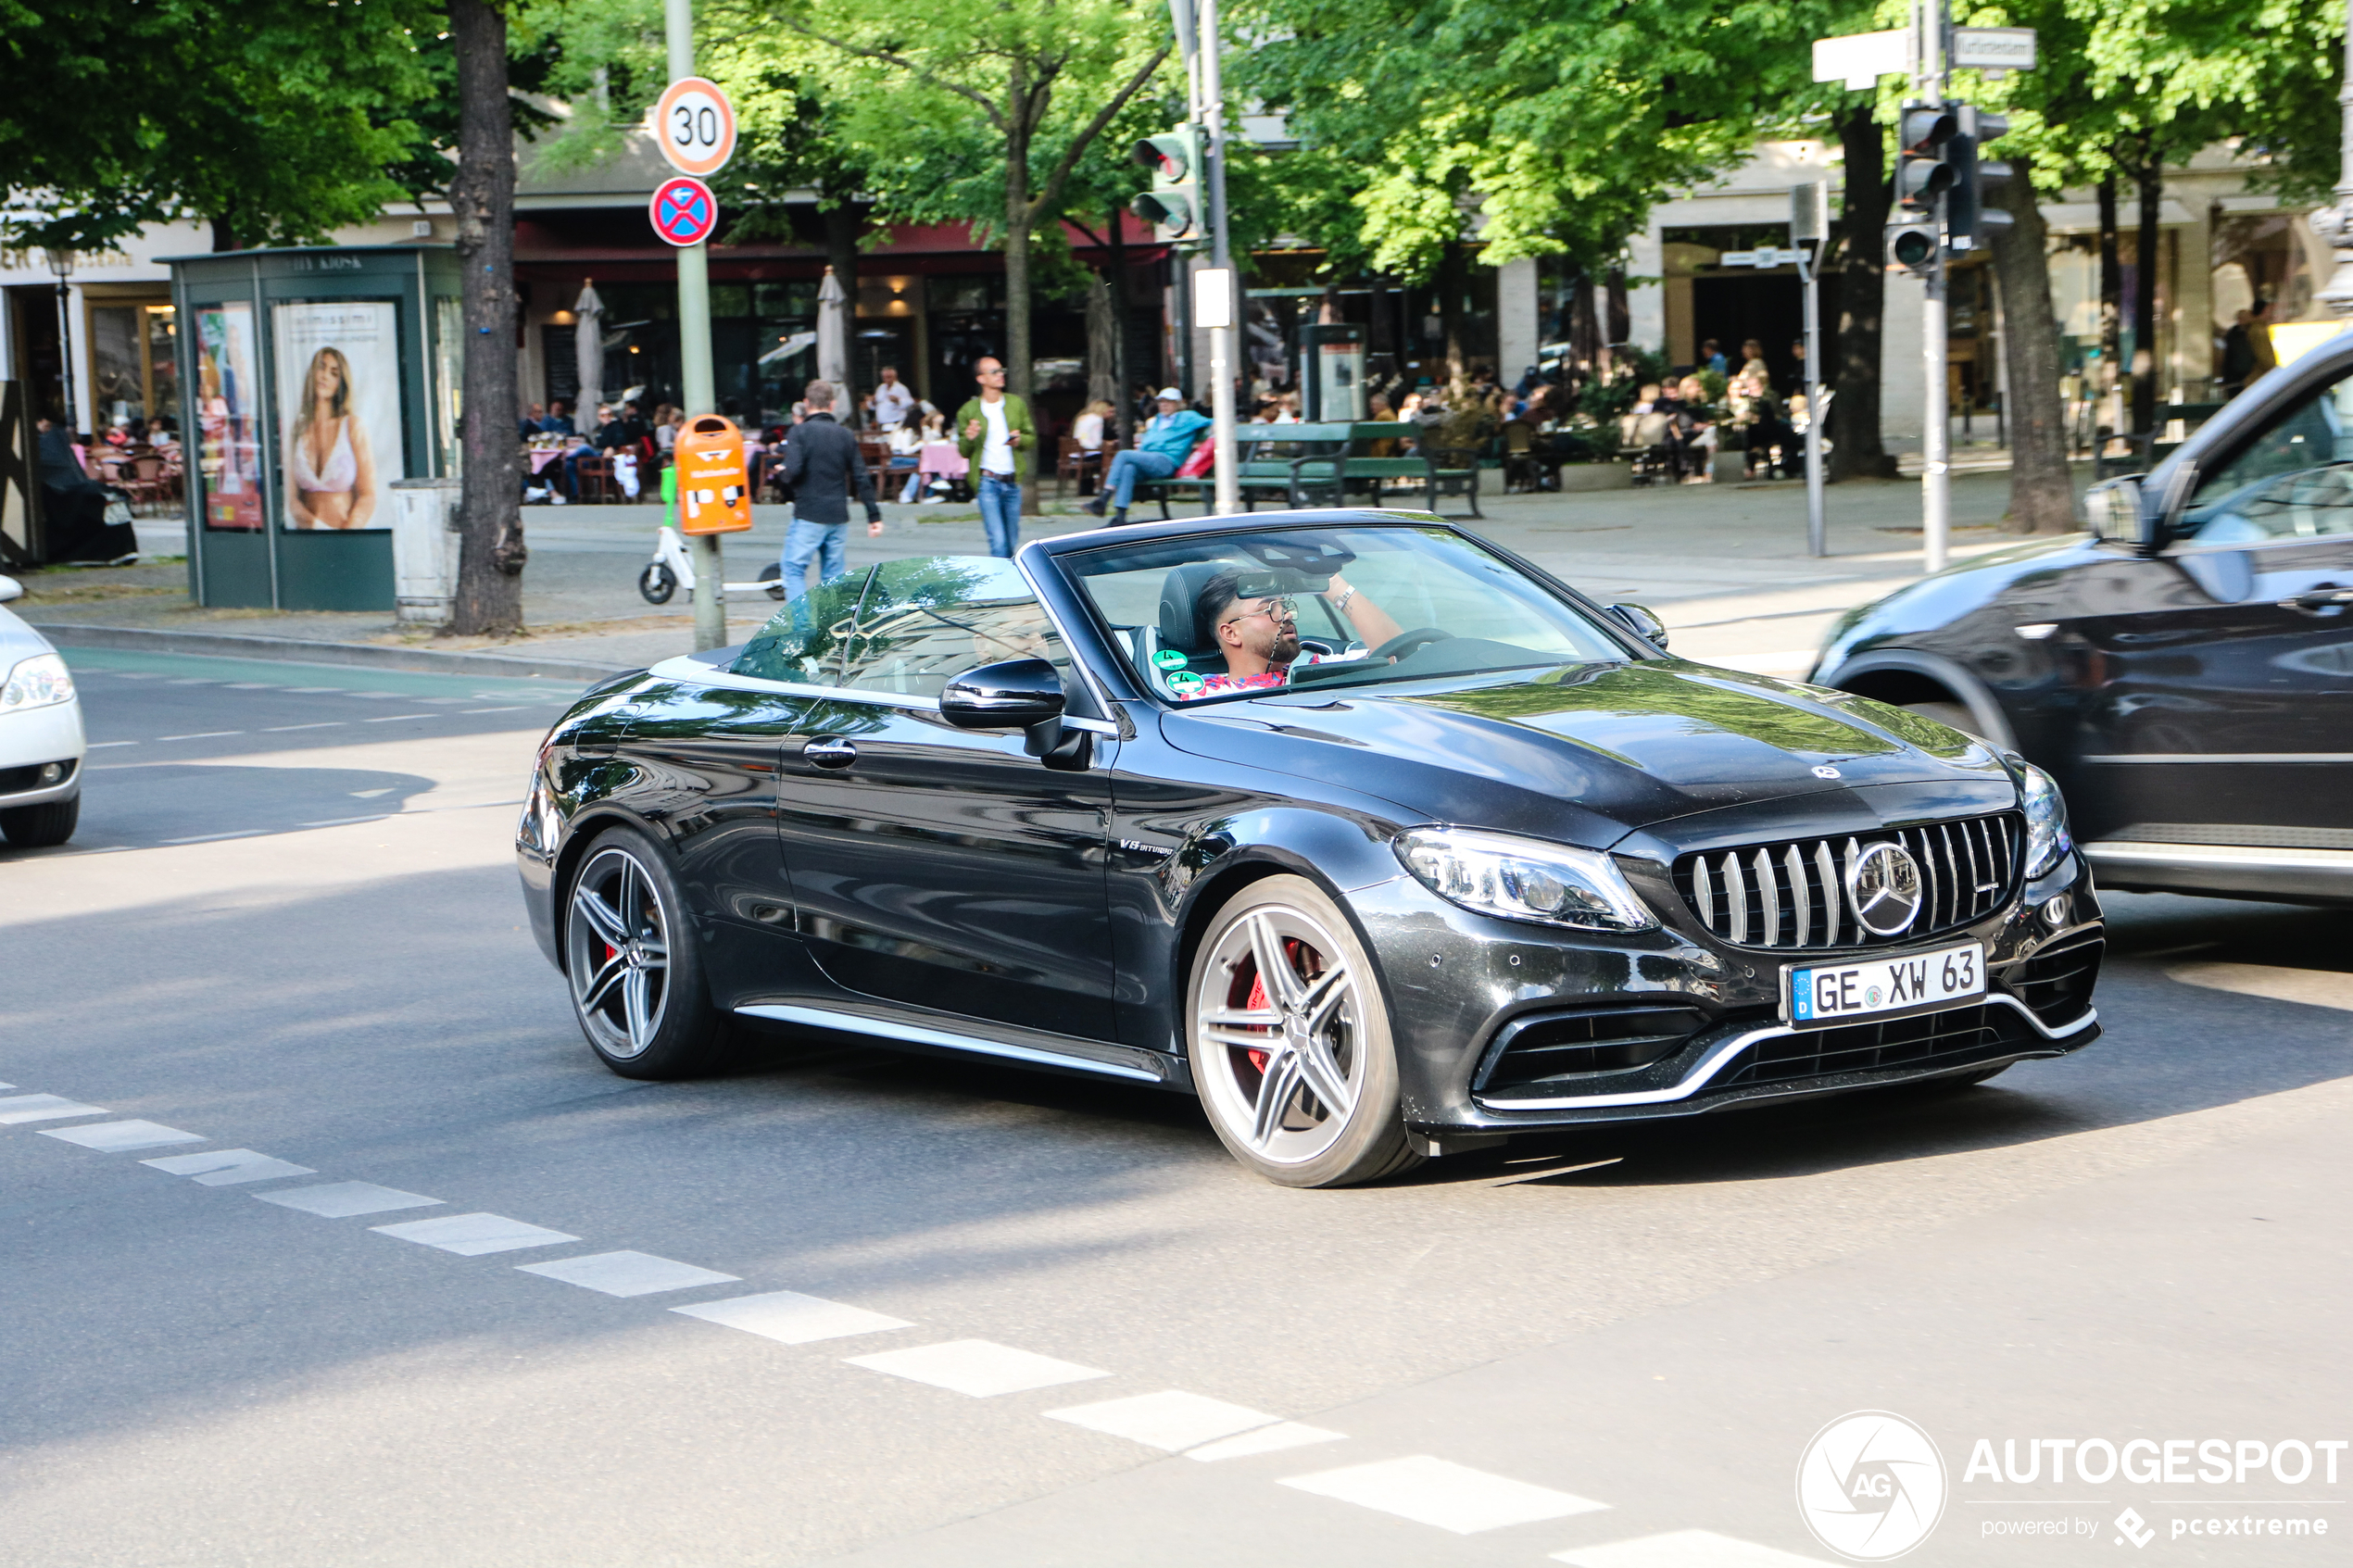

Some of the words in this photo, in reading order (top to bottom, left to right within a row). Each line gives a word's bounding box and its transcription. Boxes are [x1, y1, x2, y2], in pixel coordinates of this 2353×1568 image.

[674, 106, 716, 146] 30
[1120, 838, 1140, 850] V8
[1816, 970, 1861, 1012] GE
[1889, 960, 1927, 1004] XW
[1942, 950, 1974, 993] 63
[1798, 1001, 1806, 1014] D
